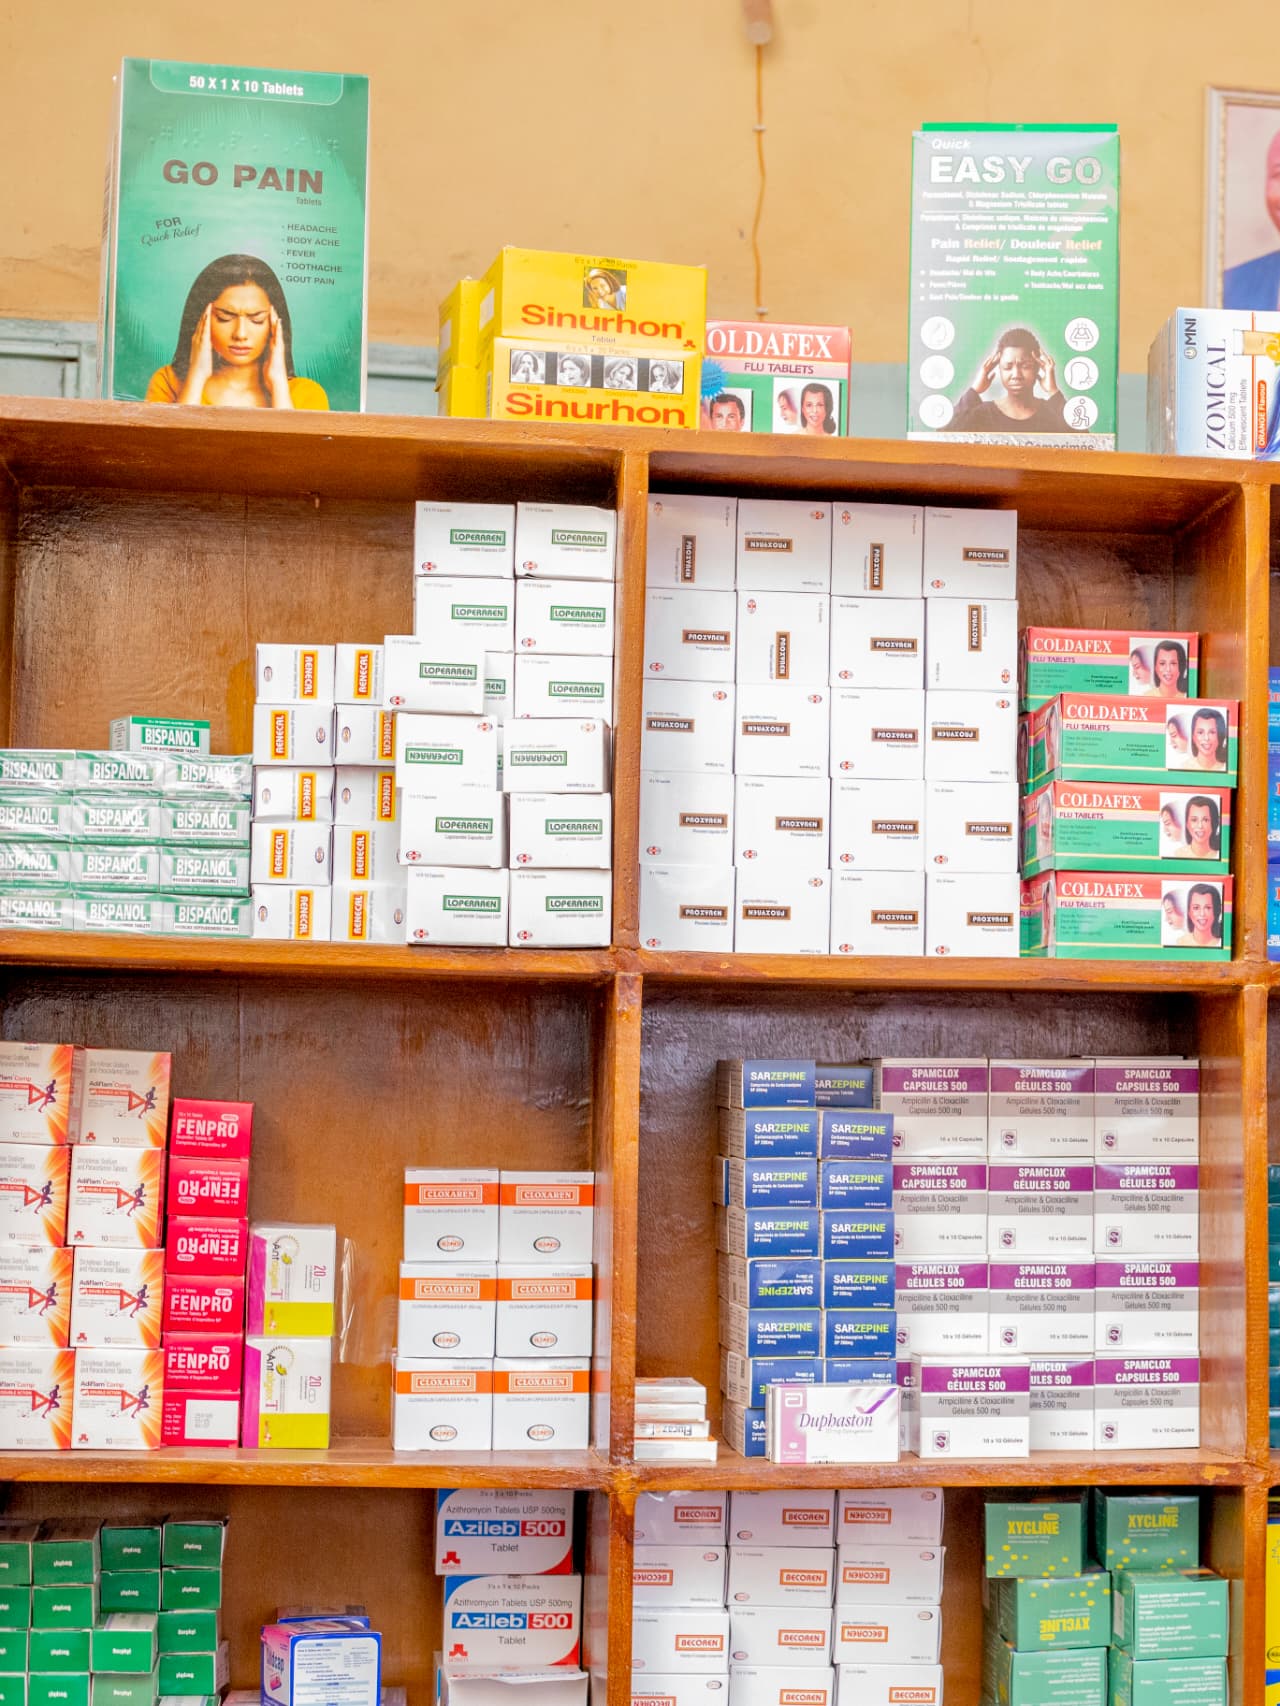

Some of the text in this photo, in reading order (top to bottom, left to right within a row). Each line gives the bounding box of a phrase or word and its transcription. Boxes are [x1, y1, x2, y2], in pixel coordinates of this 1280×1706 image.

[190, 76, 304, 97] 50 X 1 X 10 Tablets
[931, 138, 971, 150] Quick
[162, 159, 323, 194] GO PAIN
[929, 155, 1102, 185] EASY GO
[296, 197, 322, 207] Tablets
[155, 217, 182, 230] FOR
[287, 223, 337, 234] HEADACHE
[141, 224, 202, 245] Quick Relief
[287, 237, 340, 247] BODY ACHE
[931, 239, 960, 249] Pain
[1010, 239, 1062, 250] Douleur
[1066, 239, 1103, 251] Relief
[286, 249, 316, 258] FEVER
[286, 262, 343, 273] TOOTHACHE
[285, 275, 335, 285] GOUT PAIN
[521, 304, 683, 339] Sinurhon
[707, 328, 832, 359] OLDAFEX
[743, 361, 814, 375] FLU TABLETS
[1206, 339, 1226, 449] ZOMCAL
[505, 392, 685, 425] Sinurhon
[1258, 384, 1266, 446] ORANGE Flavour
[1239, 405, 1247, 450] Effervescent
[1033, 638, 1112, 654] COLDAFEX
[303, 655, 313, 696] RENECAL
[1066, 704, 1149, 721] COLDAFEX
[1066, 723, 1111, 732] FLU TABLETS
[145, 728, 196, 746] BISPANOL
[275, 714, 285, 760] RENECAL
[93, 762, 150, 780] BISPANOL
[1060, 792, 1142, 809] COLDAFEX
[176, 811, 233, 829] BISPANOL
[273, 834, 284, 877] RENECAL
[87, 855, 143, 873] BISPANOL
[750, 1071, 806, 1082] SARZEPINE
[911, 1068, 960, 1080] SPAMCLOX
[903, 1080, 968, 1091] CAPSULES 500
[909, 1106, 936, 1115] Capsules
[176, 1119, 239, 1138] FENPRO
[754, 1123, 810, 1133] SARZEPINE
[427, 1189, 475, 1199] CLOXAREN
[313, 1265, 326, 1278] 20
[423, 1284, 472, 1294] CLOXAREN
[170, 1295, 233, 1312] FENPRO
[952, 1367, 1001, 1379] SPAMCLOX
[947, 1378, 1005, 1391] GÉLULES 500
[799, 1412, 873, 1431] Duphaston
[446, 1506, 566, 1516] Azithromycin Tablets USP 500mg
[679, 1510, 716, 1519] BECOREN
[448, 1521, 561, 1535] Azileb 500
[1008, 1520, 1059, 1535] XYCLINE
[1128, 1514, 1178, 1528] XYCLINE
[491, 1544, 519, 1552] Tablet
[785, 1573, 822, 1582] BECOREN
